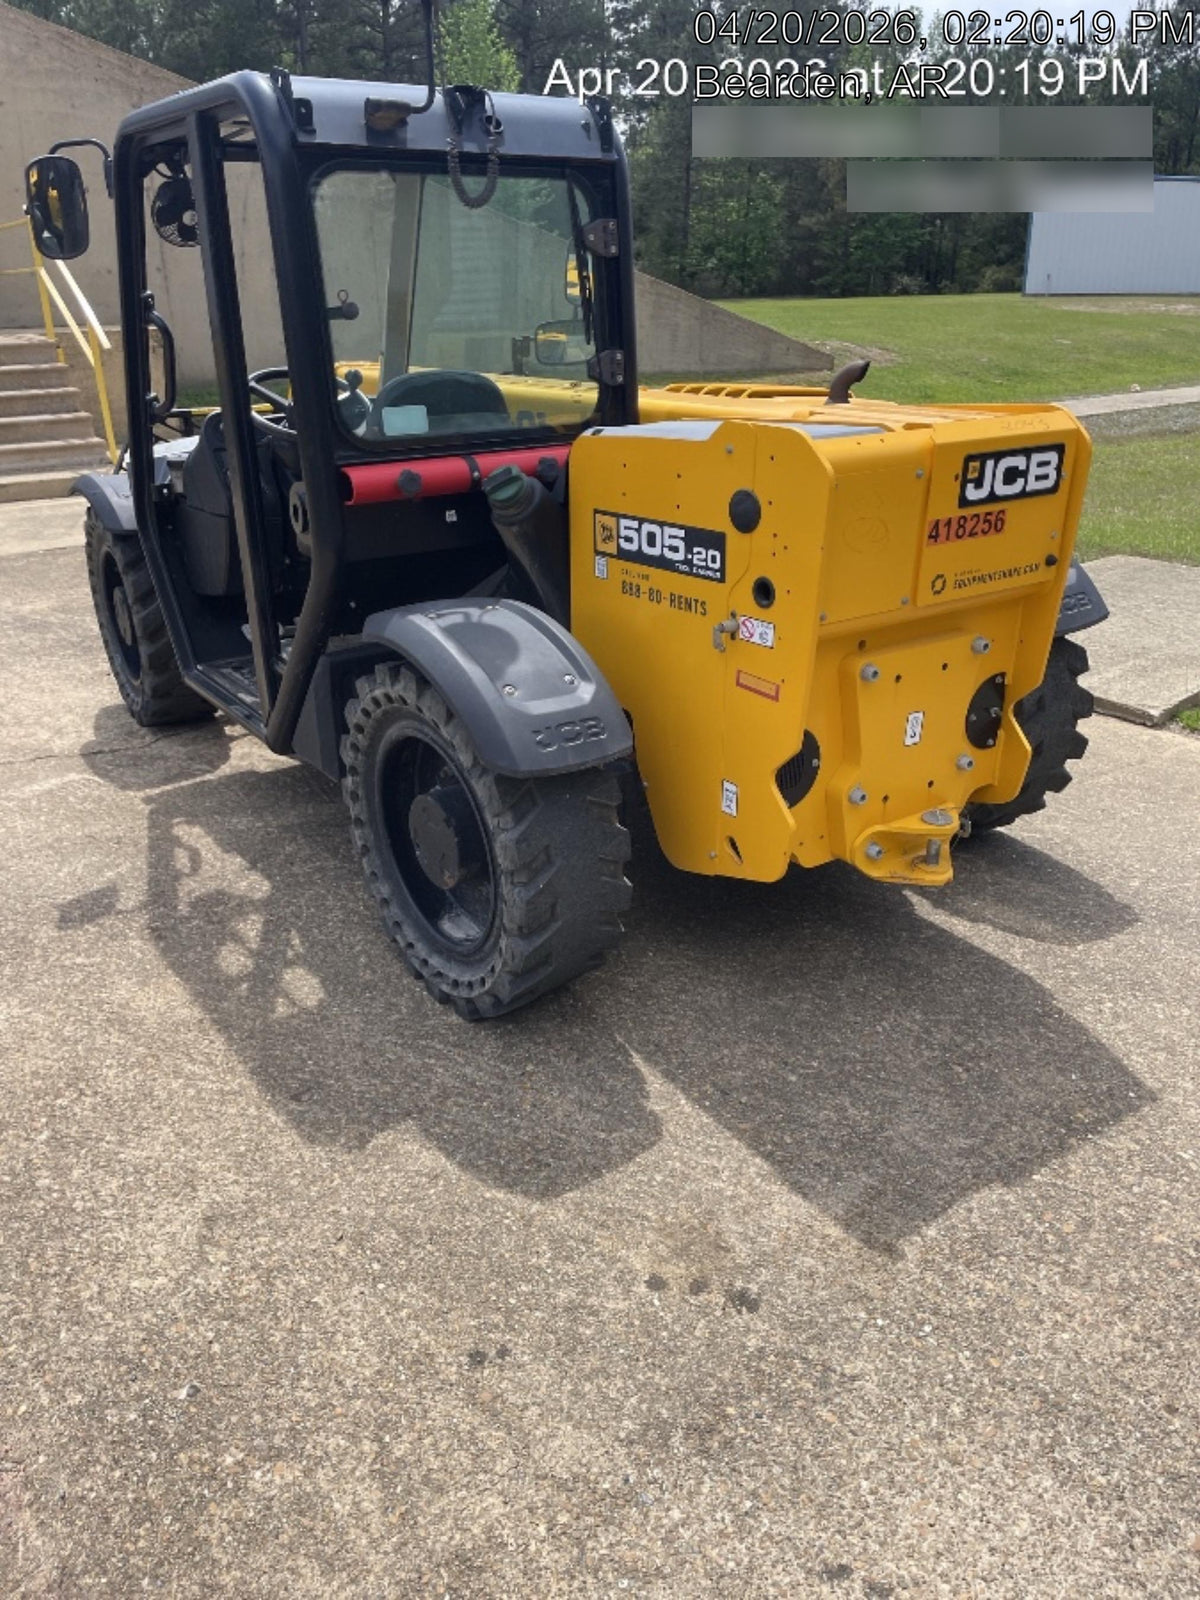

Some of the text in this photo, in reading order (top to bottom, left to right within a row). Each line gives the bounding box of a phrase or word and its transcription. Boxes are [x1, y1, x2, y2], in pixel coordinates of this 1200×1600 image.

[964, 451, 1059, 501] JCB
[928, 509, 1006, 543] 418256
[531, 716, 608, 752] JCB
